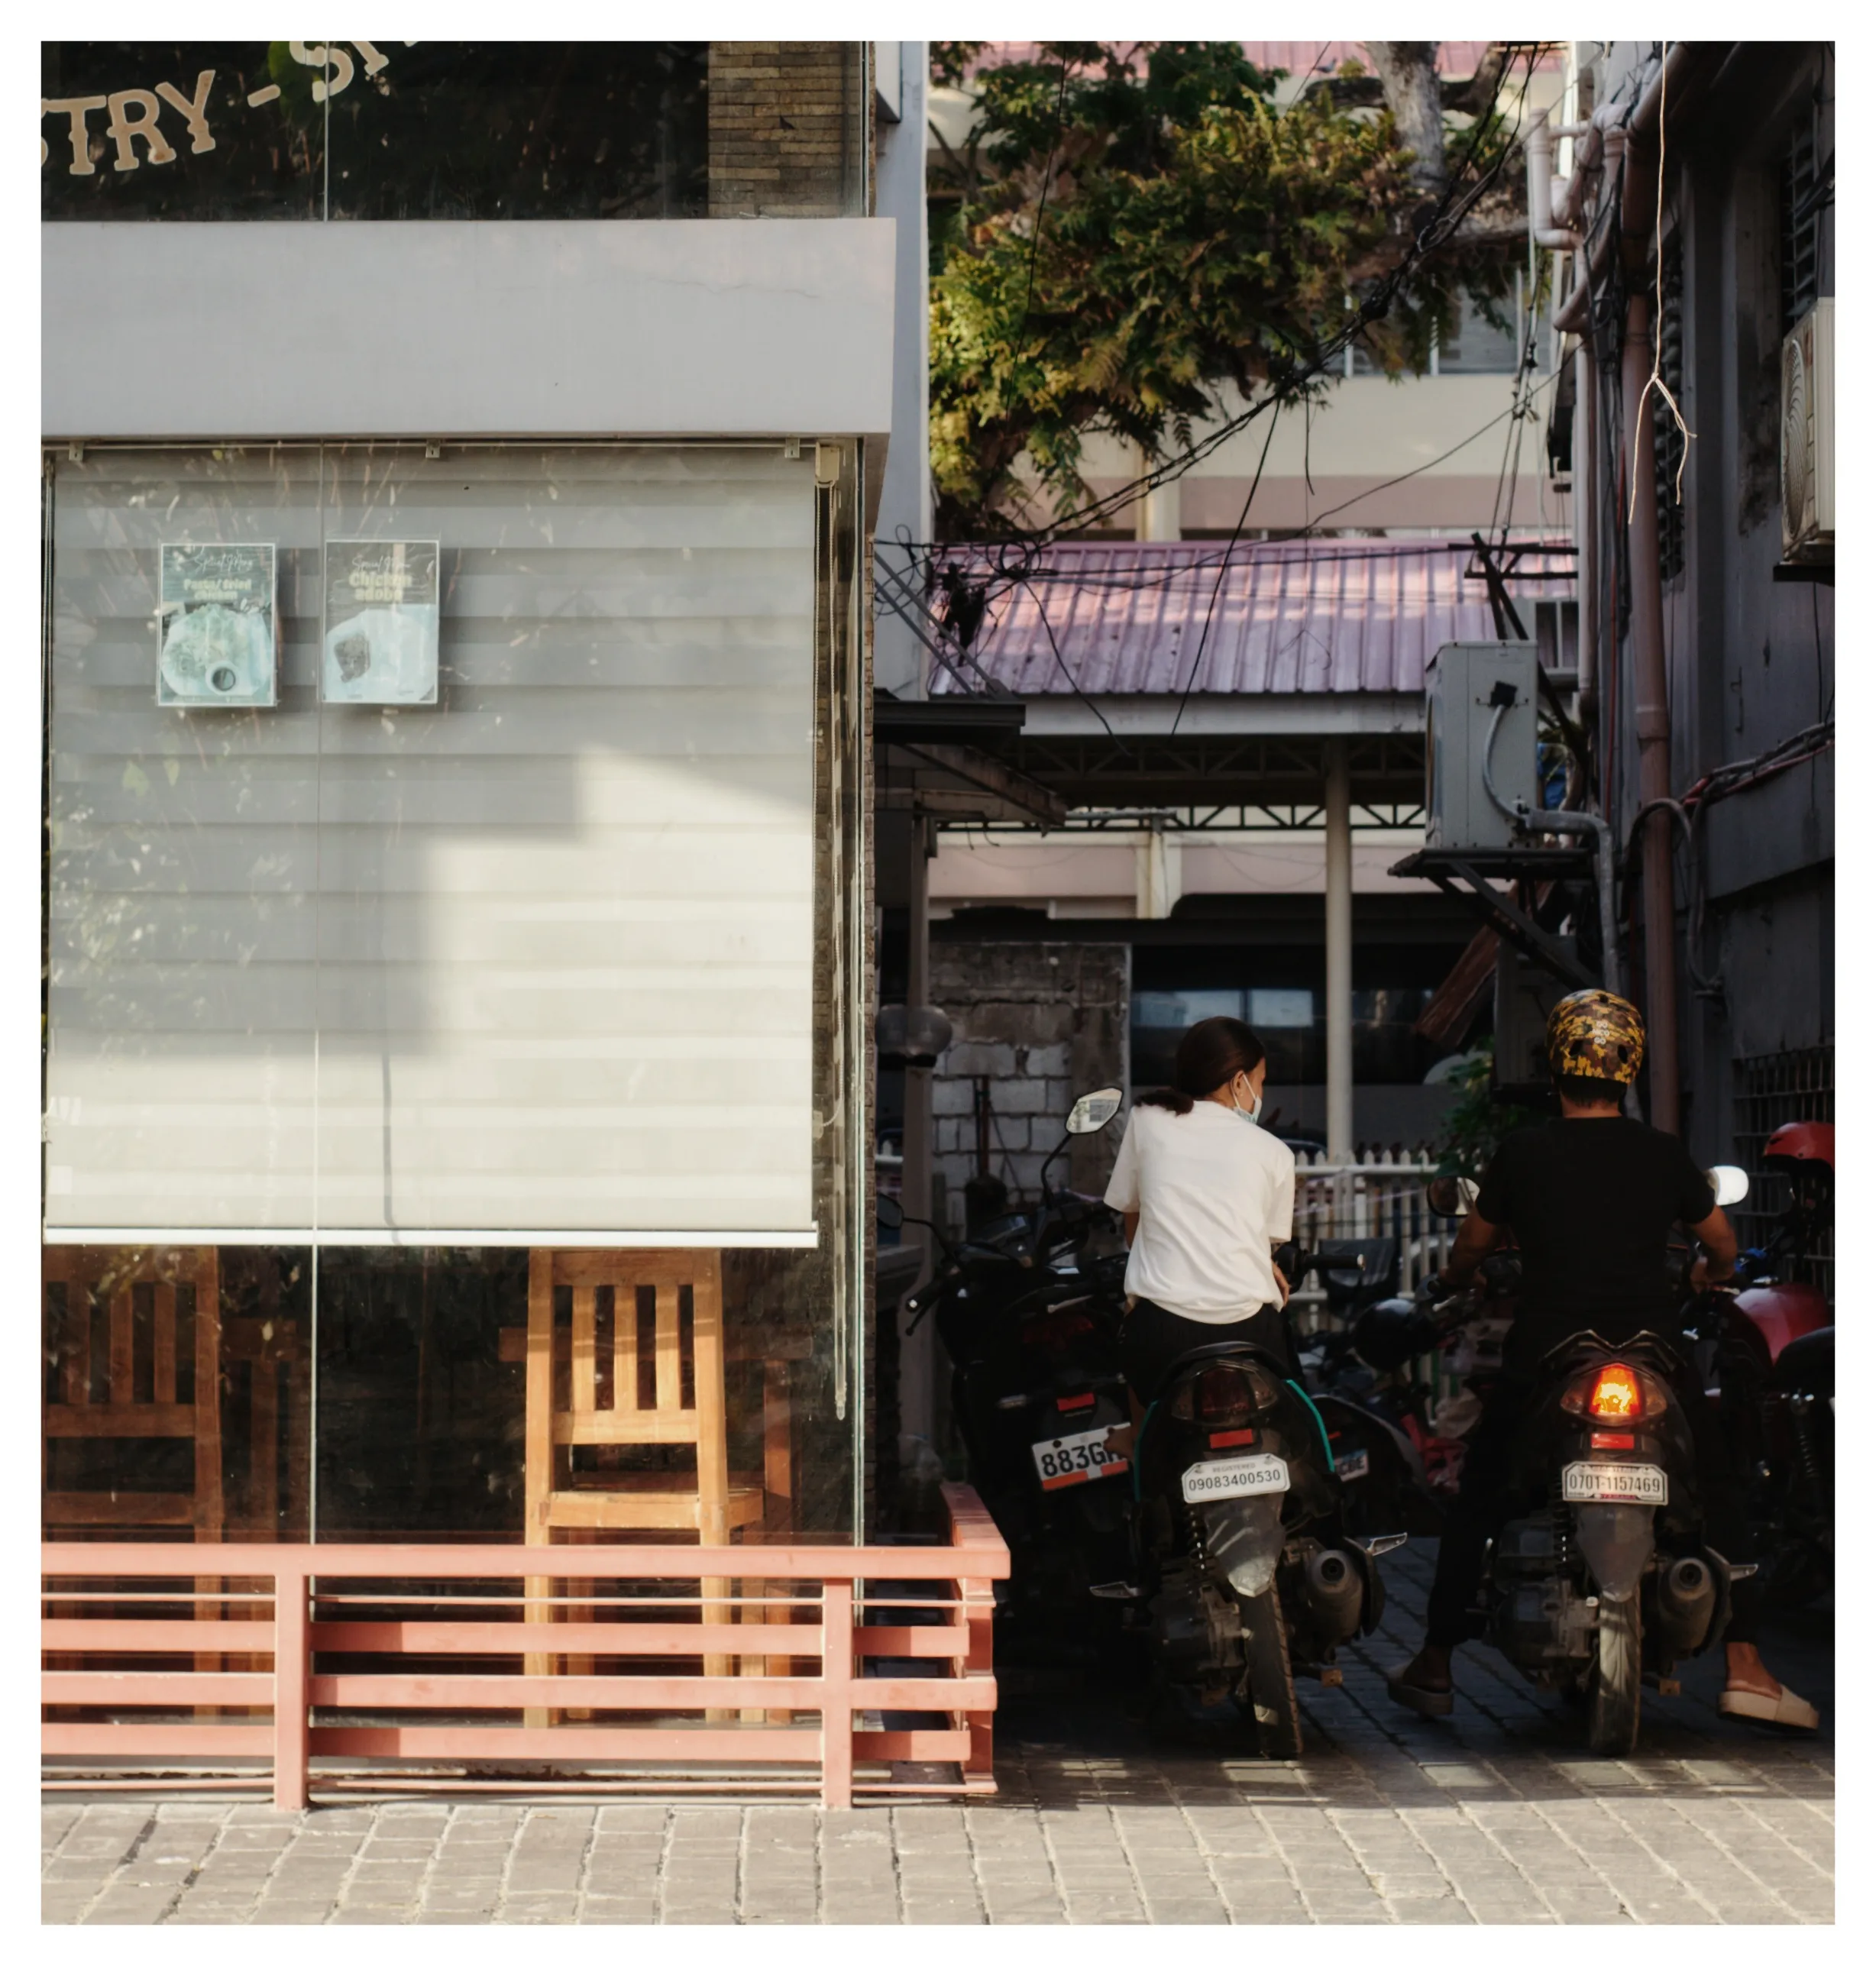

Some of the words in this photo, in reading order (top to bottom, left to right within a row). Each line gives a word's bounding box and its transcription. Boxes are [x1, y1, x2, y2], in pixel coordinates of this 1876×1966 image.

[40, 70, 216, 176] TRY
[1188, 1469, 1281, 1491] 09083400530
[1569, 1473, 1661, 1493] 0701-1157469
